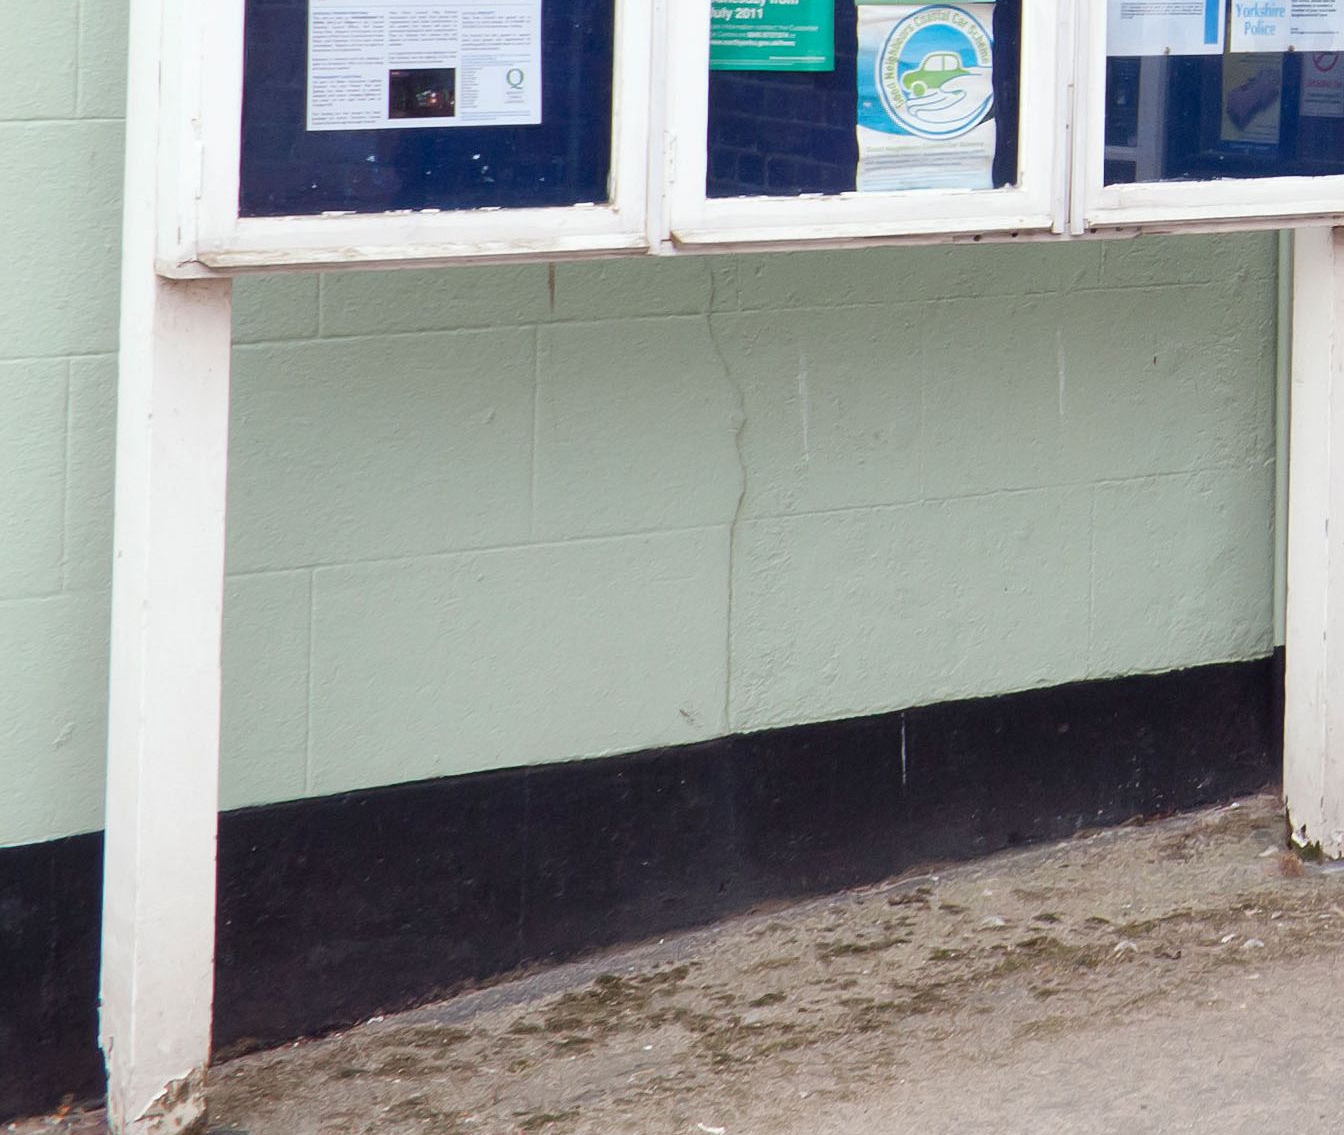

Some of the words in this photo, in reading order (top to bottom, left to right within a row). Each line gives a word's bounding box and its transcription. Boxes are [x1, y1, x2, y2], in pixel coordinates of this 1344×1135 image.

[735, 7, 764, 19] 2011
[1236, 2, 1286, 18] Yorkshire
[1244, 20, 1275, 35] Police
